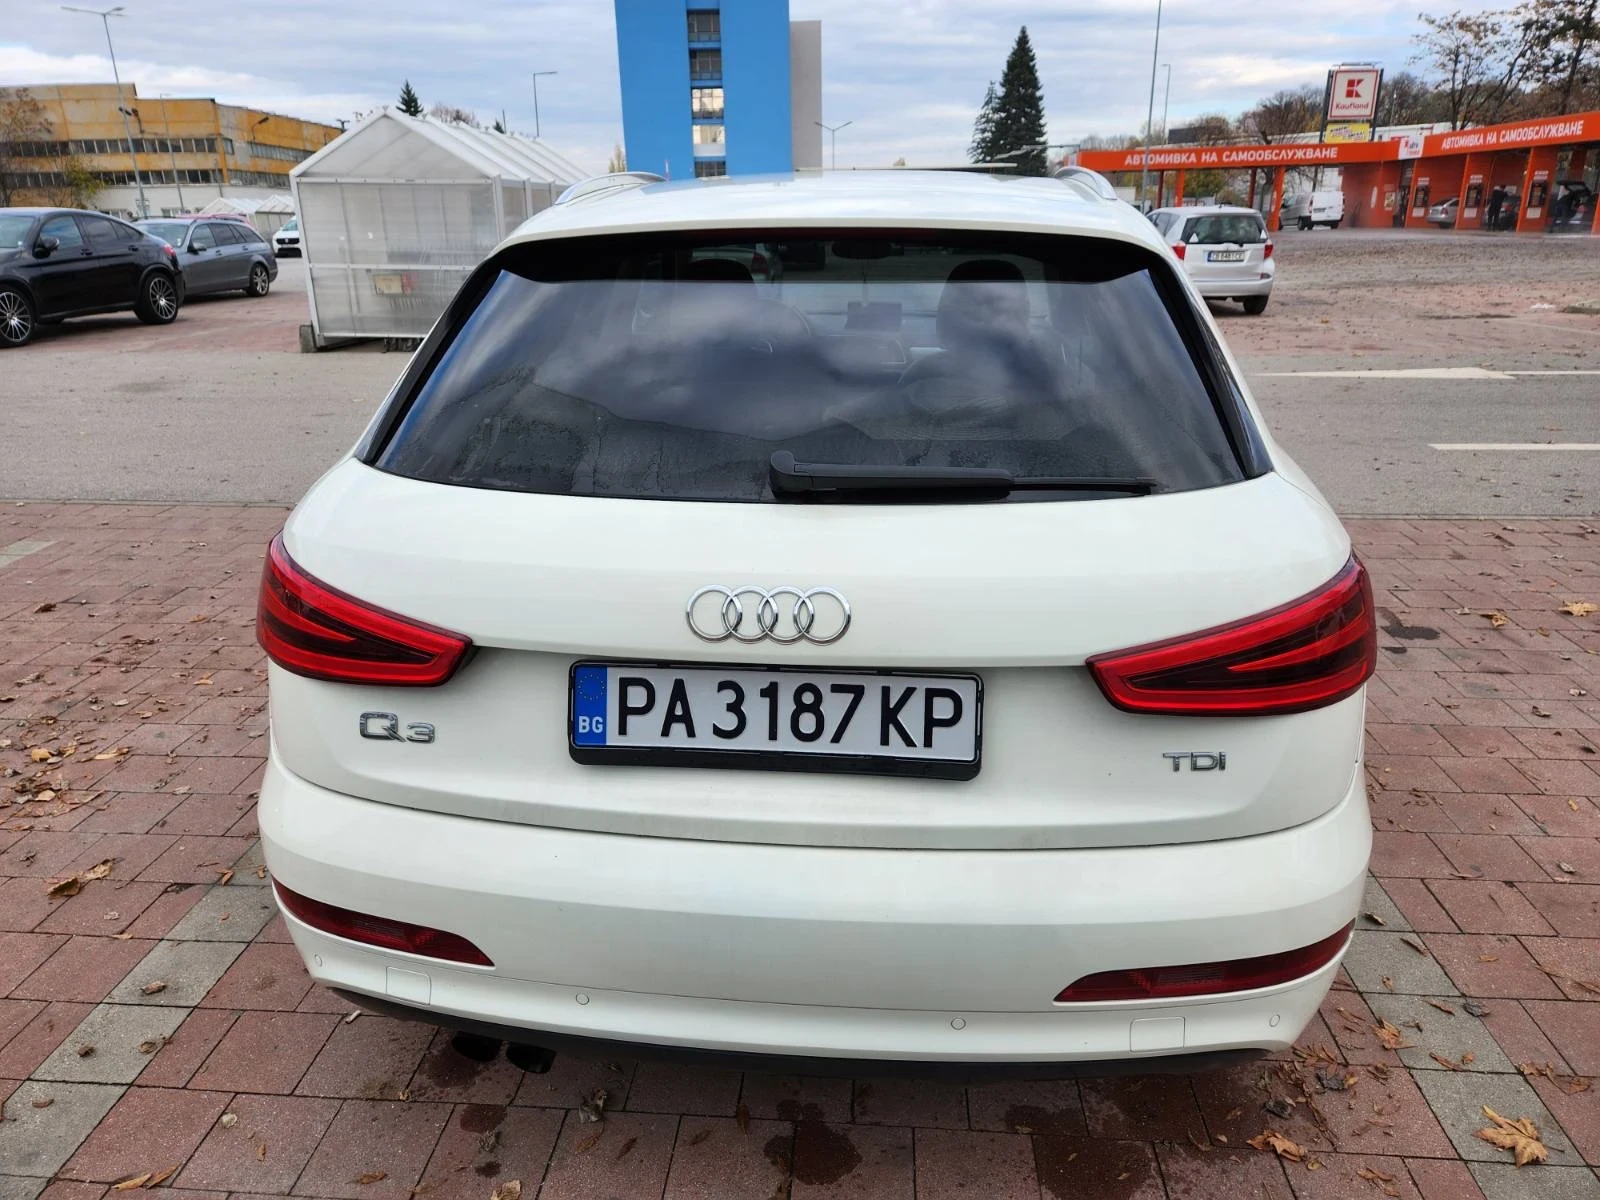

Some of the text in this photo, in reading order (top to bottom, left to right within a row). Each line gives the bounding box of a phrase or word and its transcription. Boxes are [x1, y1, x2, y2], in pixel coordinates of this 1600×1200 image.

[1335, 102, 1369, 110] Kaufland
[1441, 120, 1584, 150] АВТОМИВКА НА САМООБСЛУЖВАНЕ
[1124, 147, 1338, 166] АВТОМИВКА НА САМООБСЛУЖВАНЕ
[712, 680, 865, 744] 3187
[359, 712, 435, 744] Q3
[578, 715, 604, 734] BG
